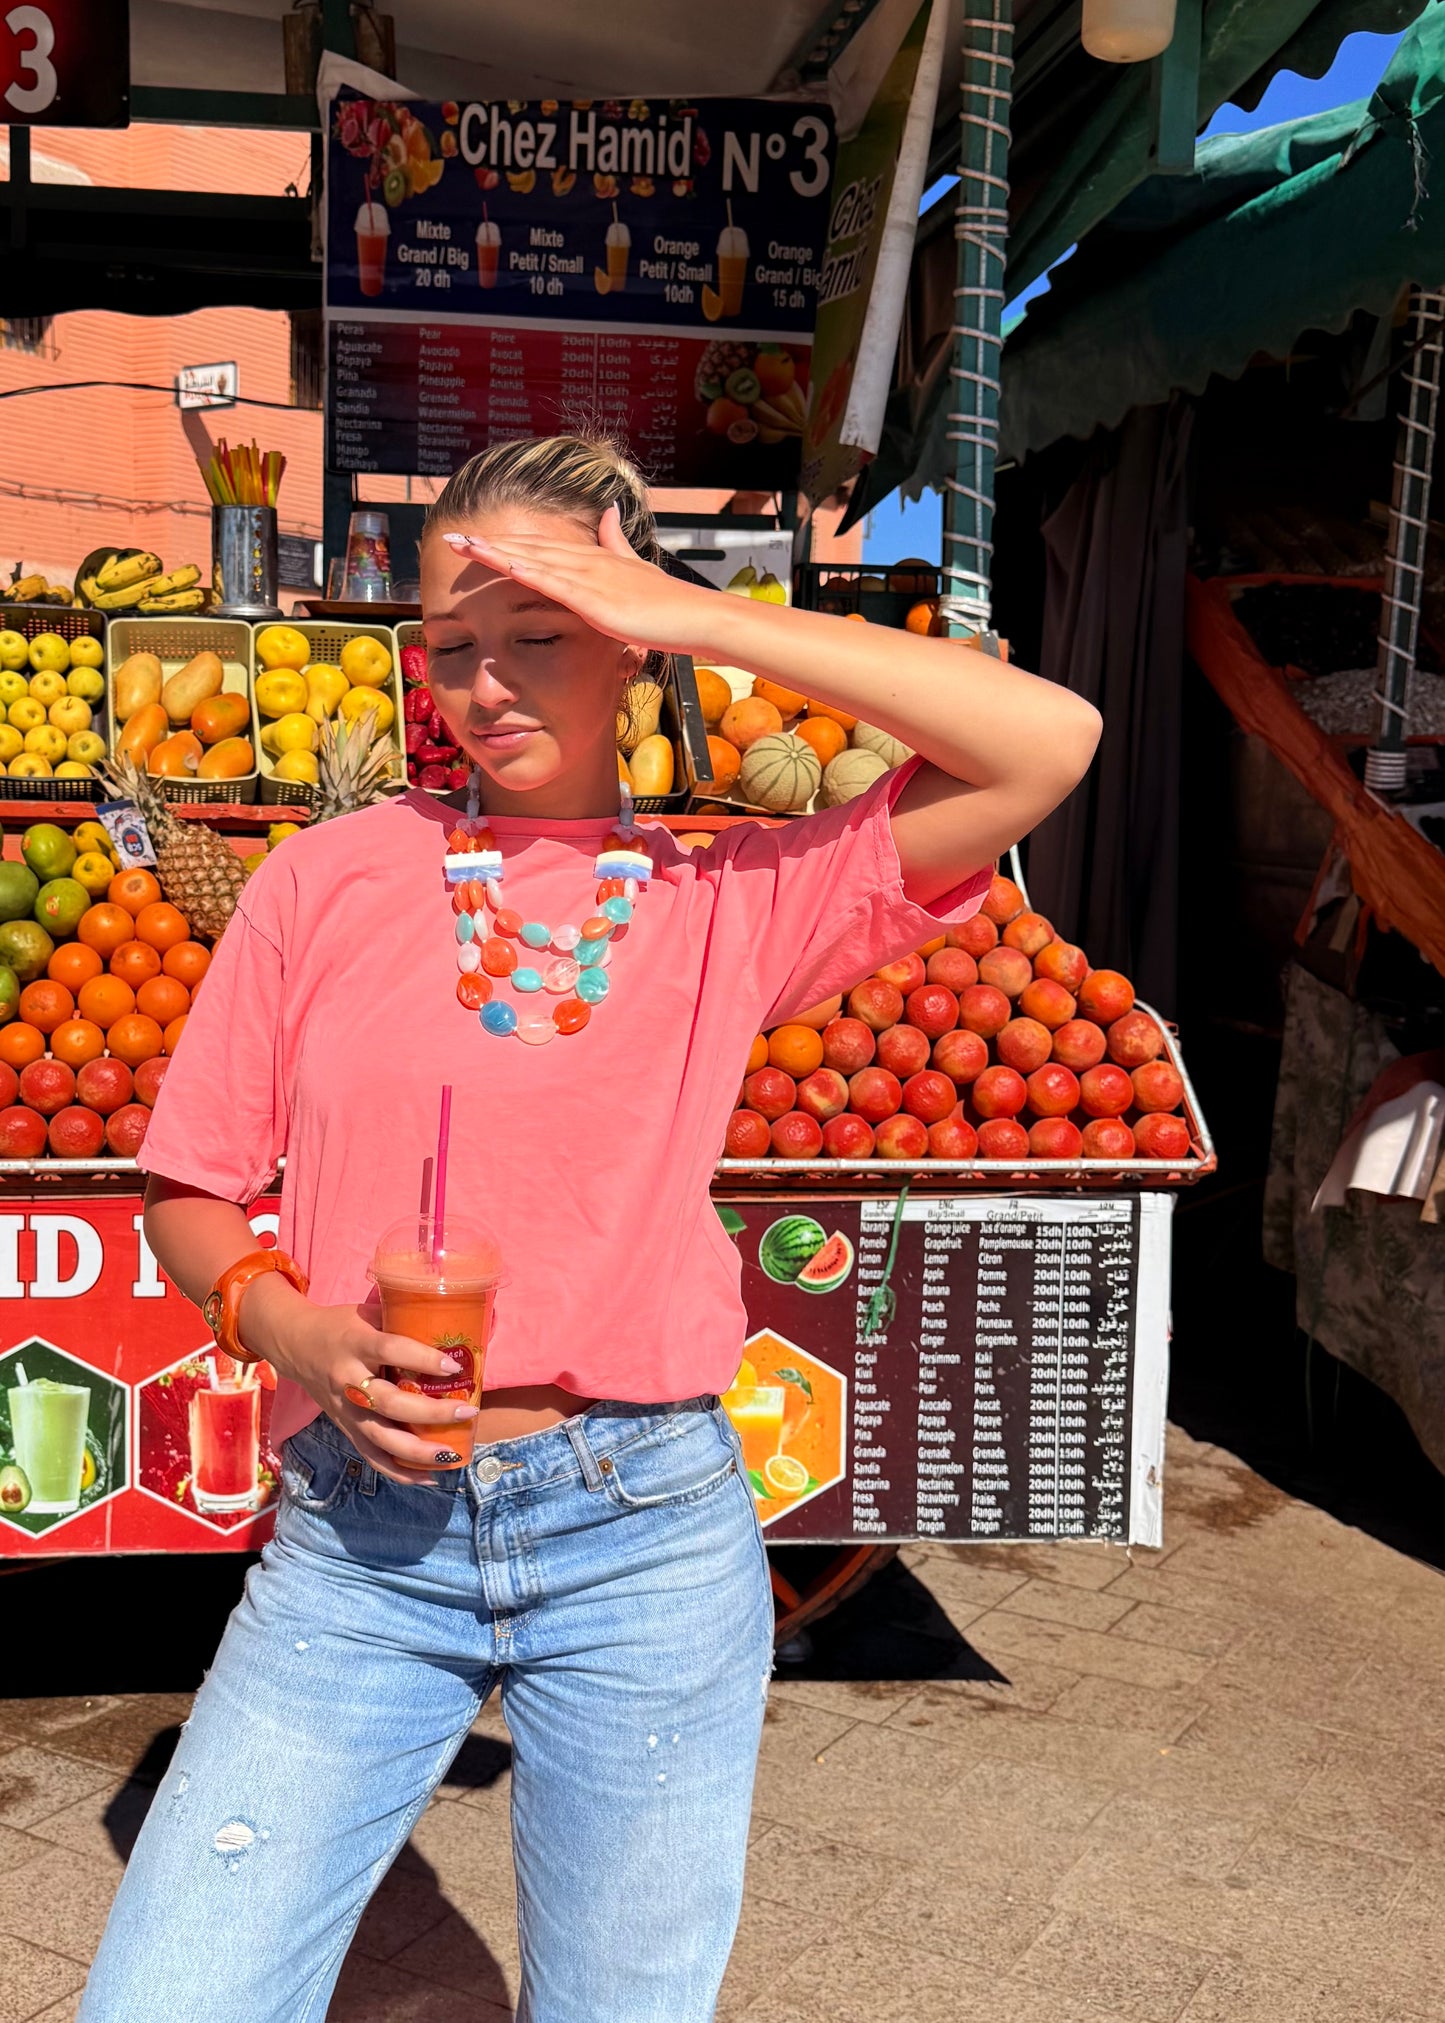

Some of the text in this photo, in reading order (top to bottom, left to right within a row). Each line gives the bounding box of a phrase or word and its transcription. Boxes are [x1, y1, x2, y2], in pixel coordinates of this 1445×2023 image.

[4, 5, 58, 114] 3
[459, 102, 557, 170] Chez
[568, 109, 692, 178] Hamid
[416, 220, 452, 241] Mixte
[529, 227, 565, 249] Mixte
[653, 235, 700, 260] Orange
[768, 240, 813, 265] Orange
[397, 244, 470, 271] Grand Big
[509, 250, 584, 275] Petit Small
[416, 268, 452, 289] 20 dh
[639, 259, 713, 283] Petit Small
[755, 264, 794, 286] Grand
[529, 275, 564, 296] 10 dh
[664, 283, 694, 304] 10dh
[772, 288, 806, 309] 15 dh
[861, 1222, 889, 1235] Naranja
[924, 1222, 950, 1236] Orange
[951, 1222, 971, 1236] juice
[980, 1222, 993, 1233] Jus
[1036, 1225, 1062, 1237] 15dh
[1066, 1225, 1092, 1237] 10dh
[860, 1236, 887, 1249] Pomelo
[978, 1236, 1034, 1251] Pamplemousse
[1035, 1238, 1061, 1250] 20dh
[1066, 1238, 1092, 1250] 10dh
[923, 1252, 949, 1264] Lemon
[978, 1252, 1002, 1265] Citron
[1034, 1253, 1061, 1265] 20dh
[1065, 1253, 1092, 1265] 10dh
[923, 1267, 1091, 1282] Apple Pomme 20dh 10dh
[922, 1284, 1091, 1296] Banana Banane 20dh 10dh
[922, 1300, 945, 1312] Peach
[1033, 1300, 1059, 1312] 20dh
[1063, 1300, 1090, 1312] 10dh
[921, 1316, 1090, 1329] Prunes Pruneaux 20dh 10dh
[920, 1333, 1089, 1348] Ginger Gingembre 20dh 10dh
[855, 1351, 1089, 1366] Caqui Persimmon Kaki 20dh 10dh
[855, 1366, 1088, 1380] Kiwi Kiwi Kiwi 20dh 10dh
[423, 1383, 452, 1391] Premium
[854, 1381, 1088, 1395] Peras Pear Poire 20dh 10dh
[854, 1399, 1087, 1414] Aguacate Avocado Avocat 20dh 10dh
[854, 1413, 1086, 1428] Papaya Papaya Papaye 20dh 10dh
[918, 1428, 956, 1444] Pineapple
[973, 1429, 1002, 1442] Ananas
[1029, 1432, 1055, 1444] 20dh
[1060, 1432, 1086, 1444] 10dh
[917, 1446, 951, 1459] Grenade
[972, 1446, 1006, 1459] Grenade
[1029, 1447, 1055, 1459] 30dh
[1059, 1447, 1085, 1459] 15dh
[853, 1461, 1085, 1476] Sandia Watermelon Pasteque 20dh 10dh
[853, 1477, 1085, 1491] Nectarina Nectarine Nectarine 20dh 10dh
[853, 1491, 1085, 1507] Fresa Strawberry Fraise 20dh 10dh
[853, 1505, 1085, 1521] Mango Mango Mangue 20dh 10dh
[853, 1519, 1084, 1534] Pitahaya Dragon Dragon 30dh 15dh
